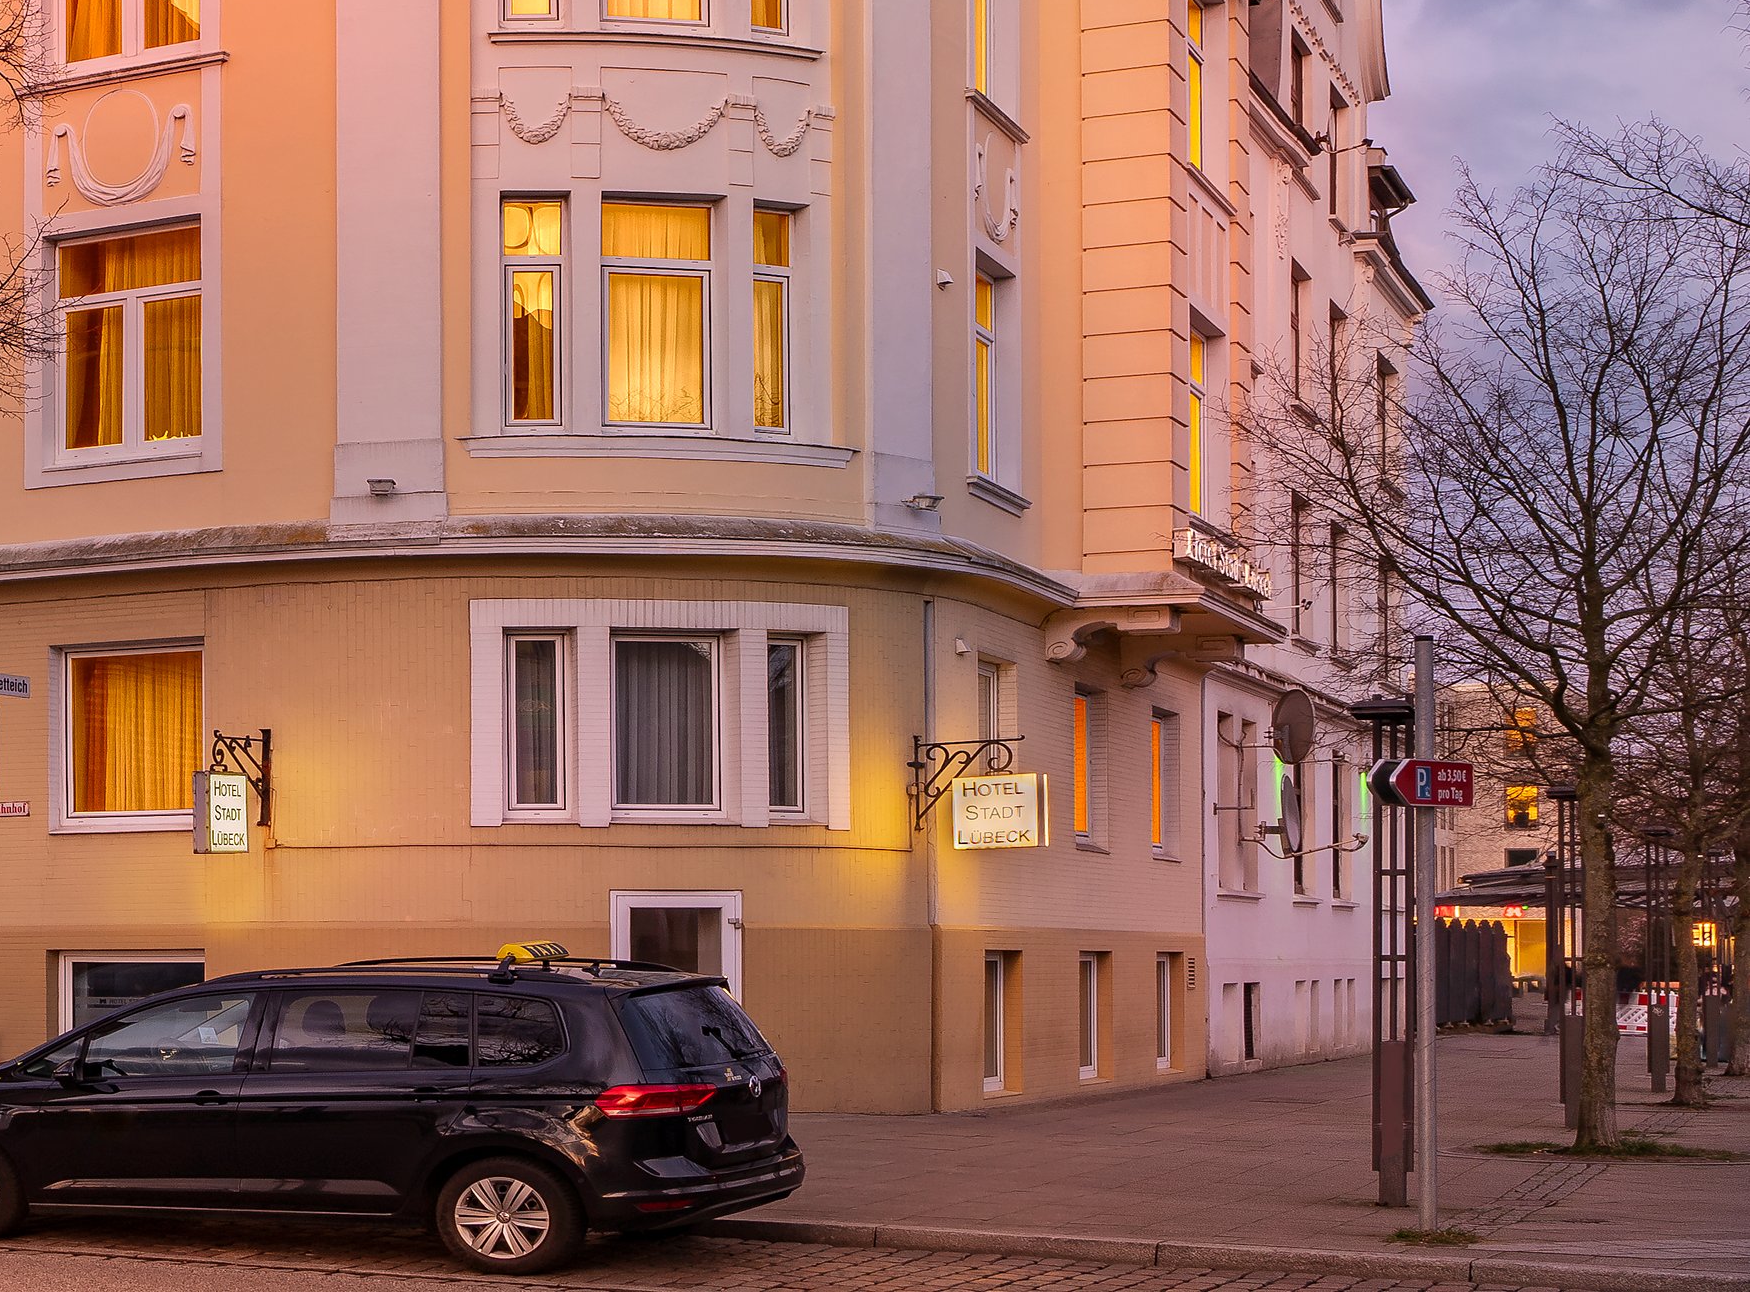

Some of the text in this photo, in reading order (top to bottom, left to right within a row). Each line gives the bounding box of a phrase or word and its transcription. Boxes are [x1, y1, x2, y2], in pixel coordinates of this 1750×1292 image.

[1437, 768, 1446, 781] ab
[213, 780, 241, 797] HOTEL
[962, 781, 1025, 797] HOTEL
[1437, 787, 1463, 802] pro Tag
[214, 804, 241, 821] STADT
[965, 805, 1025, 821] STADT
[211, 829, 245, 846] LÜBECK
[958, 829, 1031, 845] LÜBECK
[527, 943, 564, 957] TAXI
